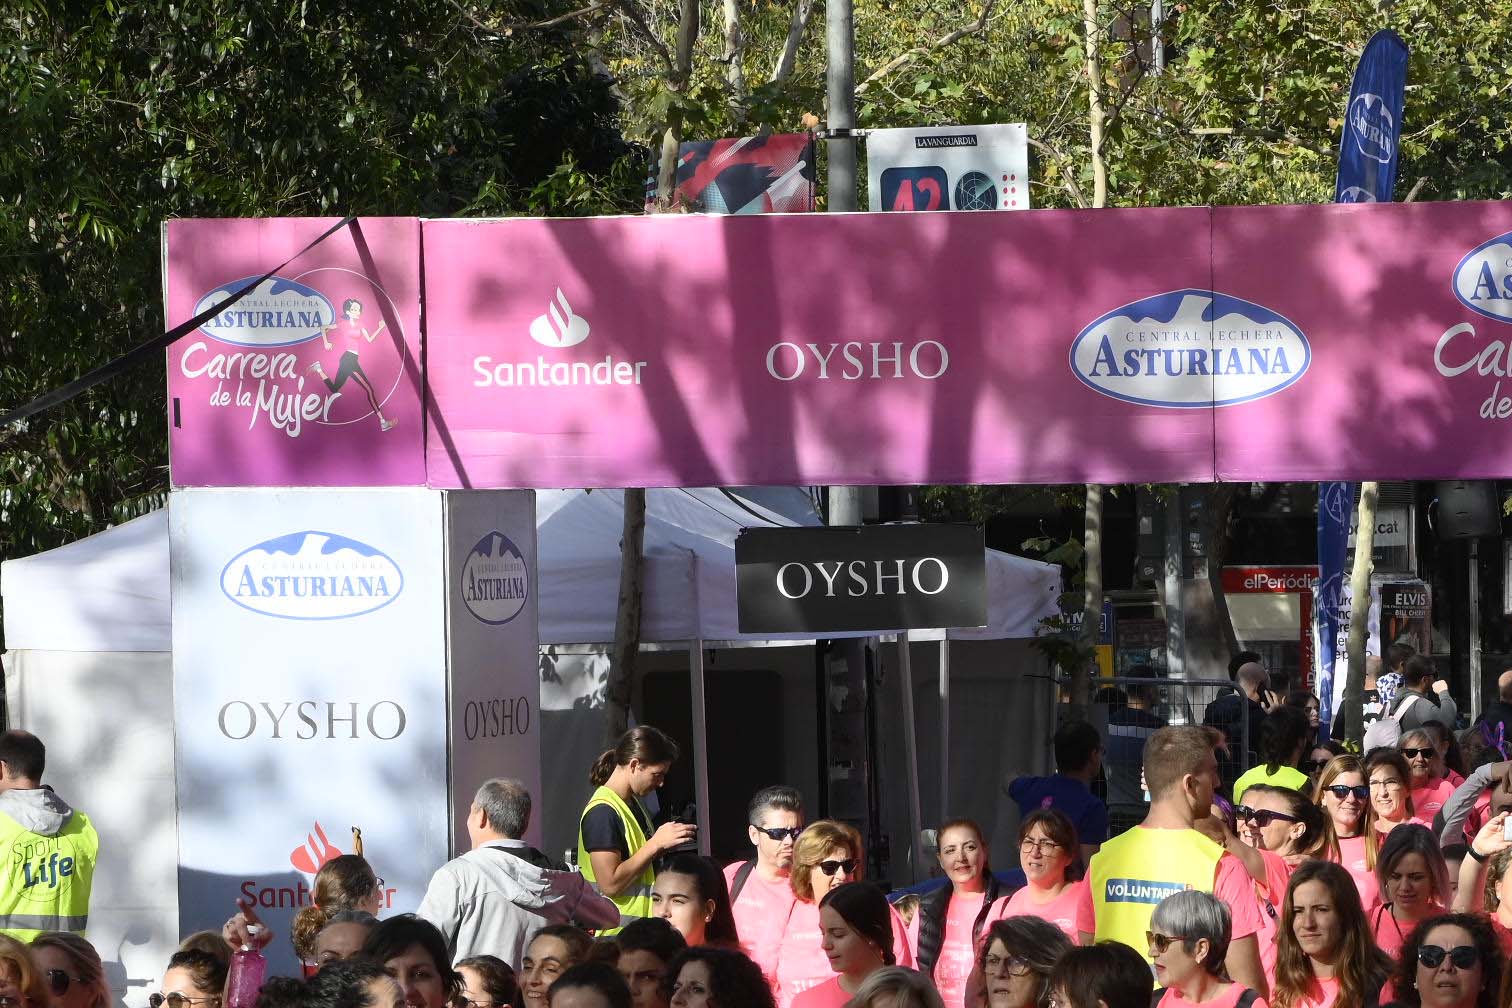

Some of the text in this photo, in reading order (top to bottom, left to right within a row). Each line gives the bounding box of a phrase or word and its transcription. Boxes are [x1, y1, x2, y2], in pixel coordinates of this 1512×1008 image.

[927, 135, 977, 147] VANGUARDIA
[204, 302, 323, 329] ASTURIANA
[1125, 329, 1285, 343] CENTRAL LECHERA
[181, 342, 297, 379] Carrera
[474, 355, 647, 387] Santander
[766, 340, 950, 381] OYSHO
[1088, 335, 1292, 379] ASTURIANA
[209, 376, 343, 438] de la Mujer
[235, 565, 390, 598] ASTURIANA
[466, 564, 525, 601] ASTURIANA
[774, 556, 951, 601] OYSHO
[1244, 574, 1316, 591] elPeriódi
[1395, 593, 1426, 606] ELVIS
[218, 700, 407, 740] OYSHO
[464, 696, 530, 741] OYSHO
[12, 838, 62, 865] Sport
[23, 853, 74, 889] Life
[240, 880, 397, 909] Santer
